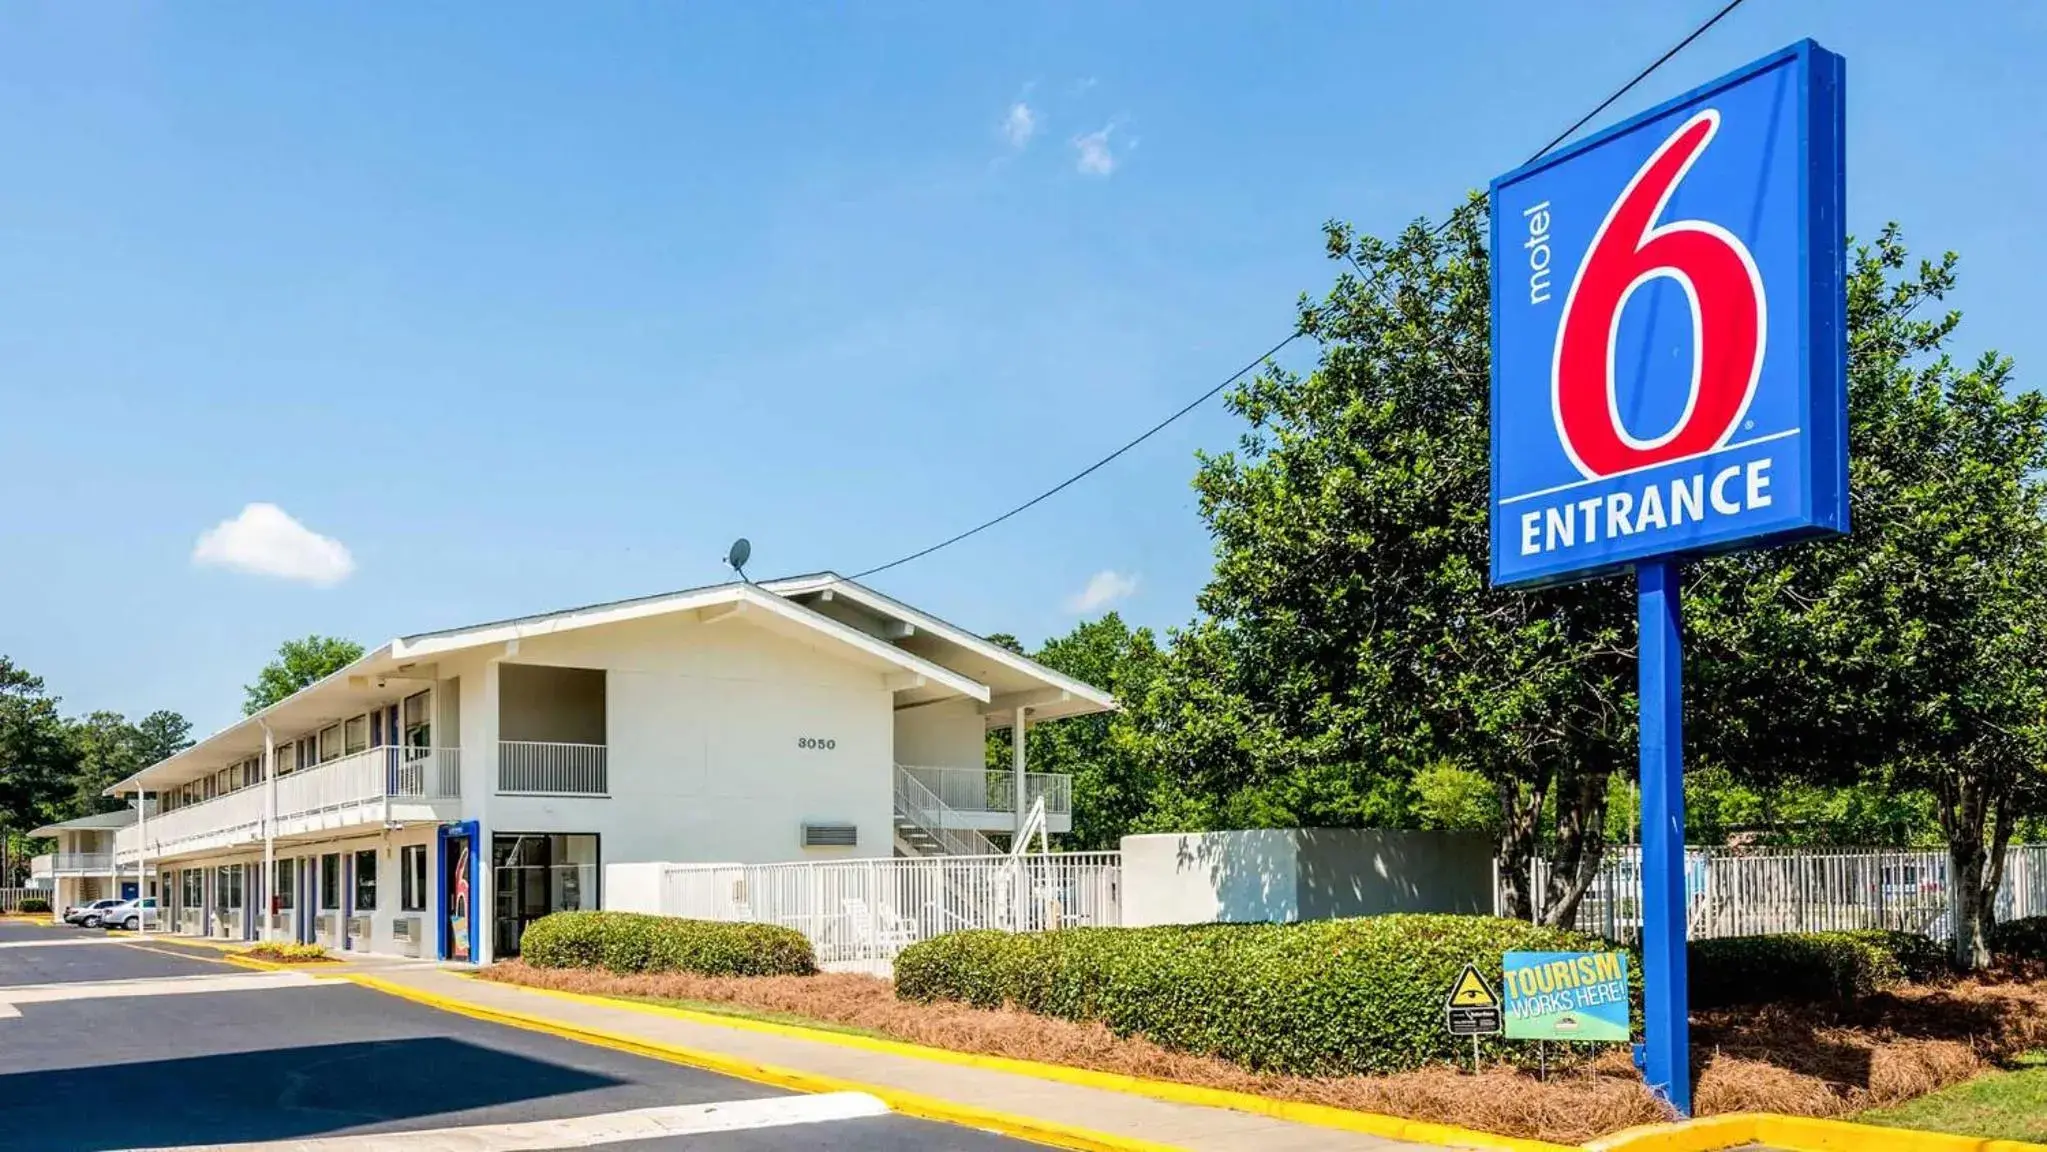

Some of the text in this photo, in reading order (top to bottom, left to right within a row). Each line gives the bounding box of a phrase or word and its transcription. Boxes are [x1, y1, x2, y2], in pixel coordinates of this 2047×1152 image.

[1523, 200, 1551, 305] motel
[1551, 108, 1767, 481] 6
[1519, 457, 1773, 556] ENTRANCE
[798, 737, 836, 750] 3050
[1504, 952, 1622, 999] TOURISM
[1511, 981, 1627, 1019] WORKS HERE!
